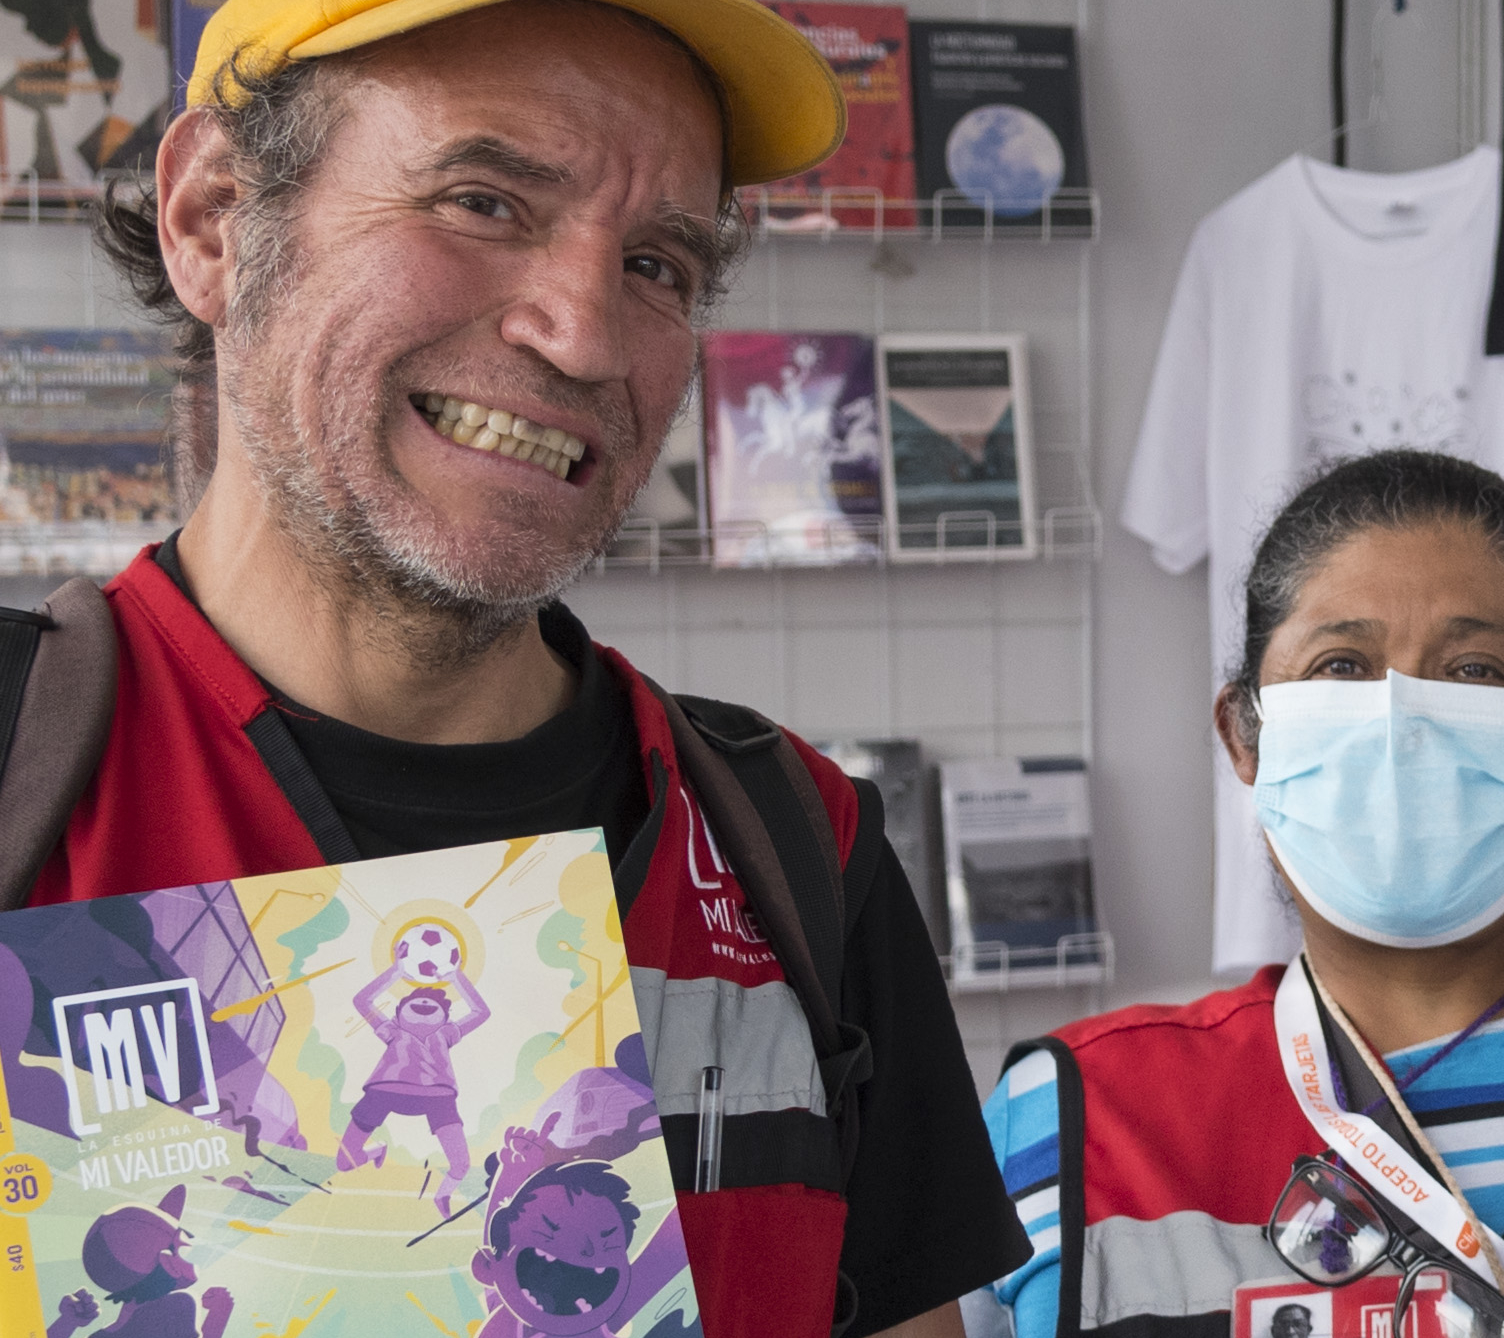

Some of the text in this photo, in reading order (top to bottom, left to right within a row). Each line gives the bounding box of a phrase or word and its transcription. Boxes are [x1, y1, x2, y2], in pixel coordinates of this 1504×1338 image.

[700, 897, 732, 933] MI
[83, 1001, 180, 1114] MV
[1292, 1032, 1430, 1204] ACEPTO TARJETAS
[113, 1123, 193, 1148] ESQUINA
[3, 1163, 34, 1175] VOL
[78, 1135, 232, 1192] MI VALEDOR
[3, 1175, 40, 1204] 30
[6, 1244, 26, 1272] $40
